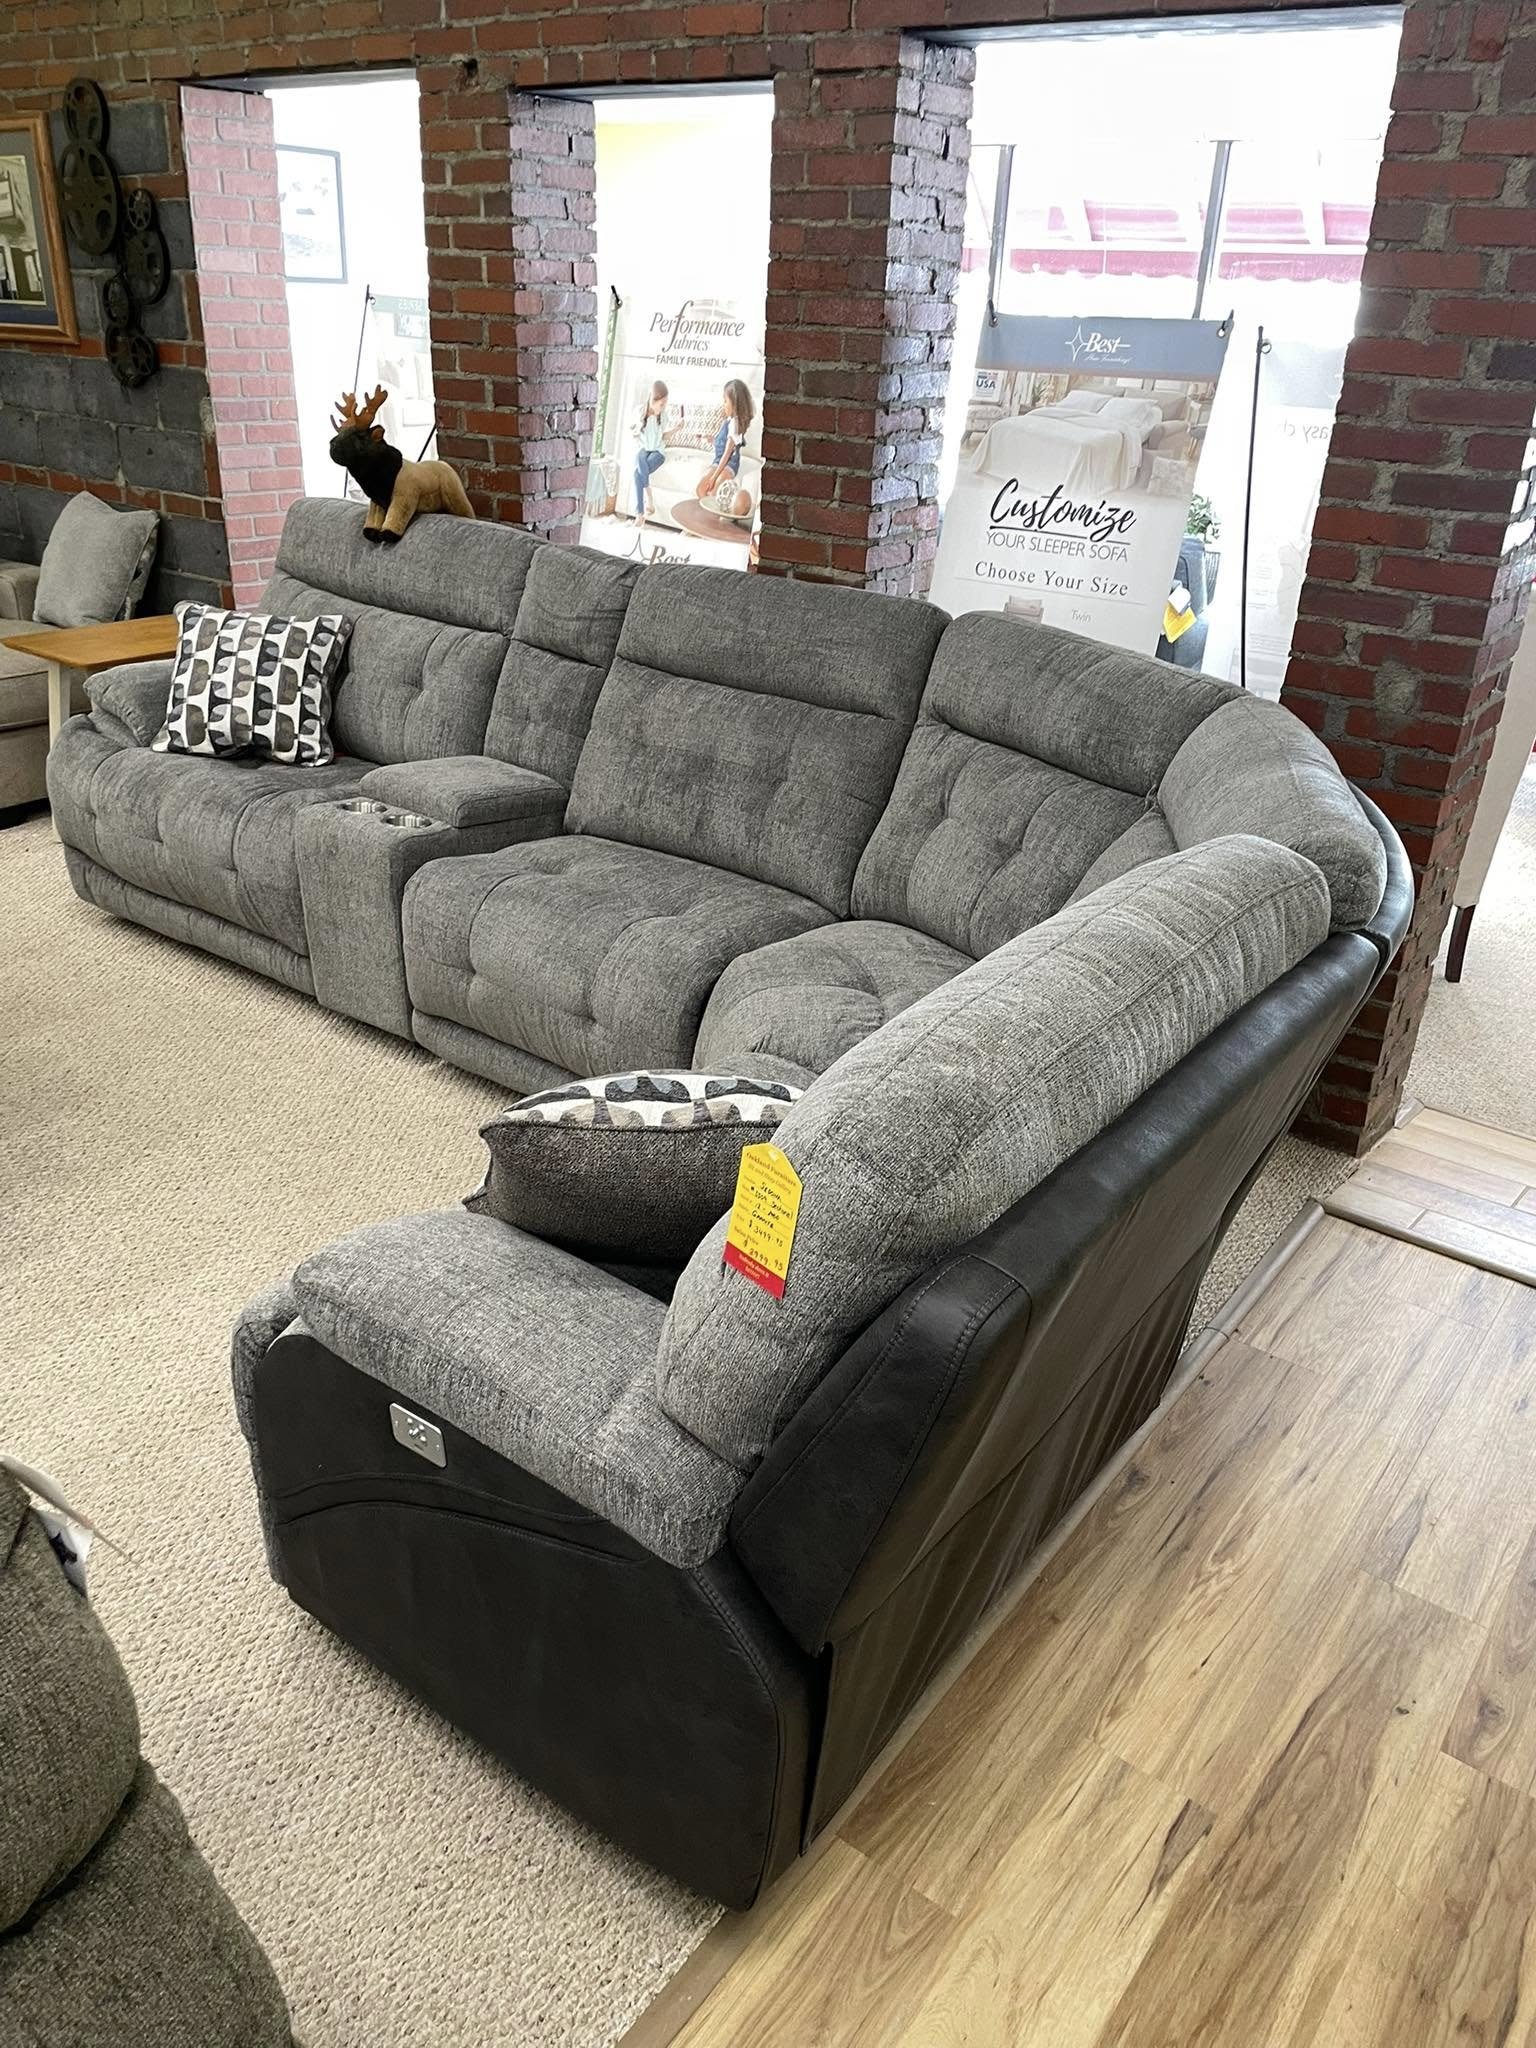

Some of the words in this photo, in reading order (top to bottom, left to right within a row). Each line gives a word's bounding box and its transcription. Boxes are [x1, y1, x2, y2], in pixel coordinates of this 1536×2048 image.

[649, 300, 745, 338] Performance
[1084, 332, 1122, 354] Best
[656, 355, 686, 366] FAMILY
[976, 378, 996, 390] USA
[990, 477, 1138, 542] Customize
[986, 531, 1025, 550] YOUR
[1029, 536, 1086, 558] SLEEPER
[1089, 544, 1128, 563] SOFA
[975, 560, 1036, 584] Choose
[1044, 570, 1084, 590] Your
[1090, 576, 1129, 596] Size
[1071, 608, 1091, 623] Twin
